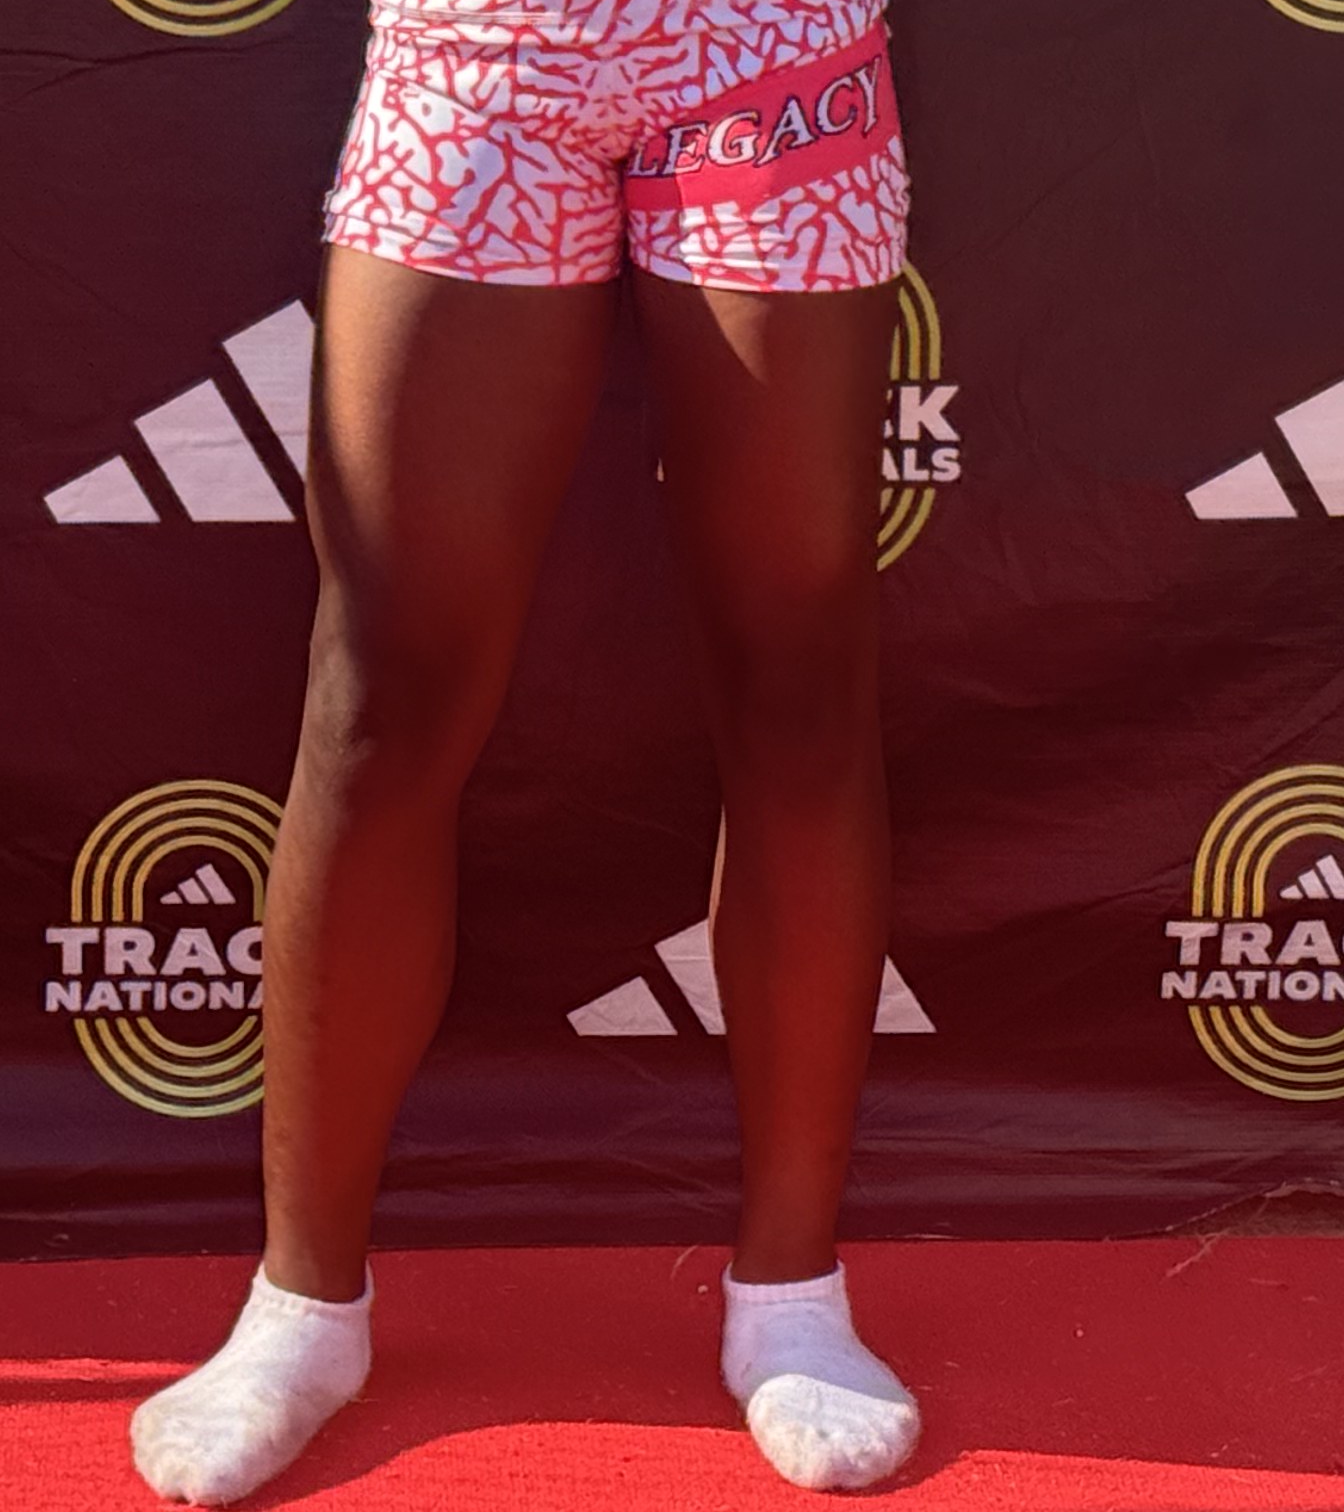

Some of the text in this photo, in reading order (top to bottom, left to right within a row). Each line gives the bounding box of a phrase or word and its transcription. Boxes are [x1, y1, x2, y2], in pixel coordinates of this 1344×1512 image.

[626, 53, 884, 178] LEGACY
[45, 926, 264, 976] TRAC
[45, 980, 264, 1012] NATION
